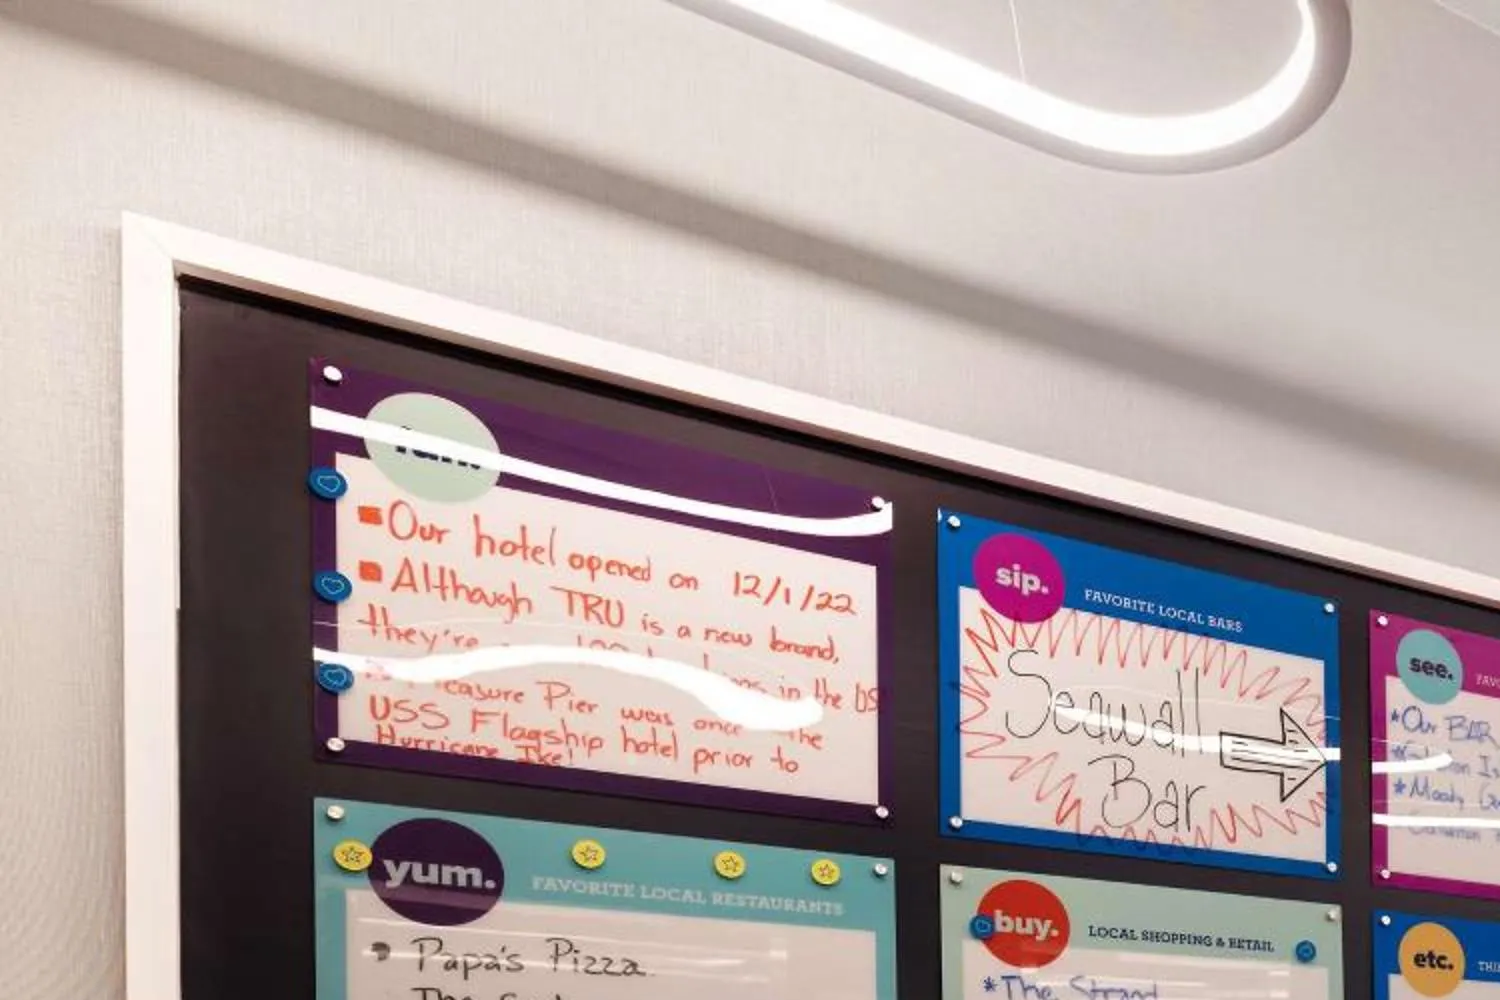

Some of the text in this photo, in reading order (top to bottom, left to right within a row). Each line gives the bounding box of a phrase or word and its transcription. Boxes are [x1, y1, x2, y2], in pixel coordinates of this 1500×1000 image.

[388, 500, 856, 615] Our hotel opened on 12/1/22
[995, 563, 1049, 596] sip.
[391, 557, 839, 664] Although TRU is a new brand,
[1085, 588, 1243, 633] FAVORITE LOCAL BARS
[357, 603, 479, 650] they're
[778, 676, 801, 701] in
[1408, 657, 1454, 681] see.
[536, 681, 599, 714] Pier
[621, 706, 674, 726] was
[693, 717, 743, 736] once
[1005, 649, 1203, 758] Seawall
[1401, 705, 1437, 734] Our
[369, 694, 799, 774] USS Flagship hotel prior to
[1087, 754, 1207, 832] Bar
[383, 858, 497, 888] yum.
[532, 875, 846, 917] FAVORITE LOCAL RESTAURANTS
[994, 909, 1060, 941] buy.
[1088, 925, 1276, 953] LOCAL SHOPPING & RETAIL
[411, 936, 525, 981] Papa's
[1413, 951, 1454, 971] etc.
